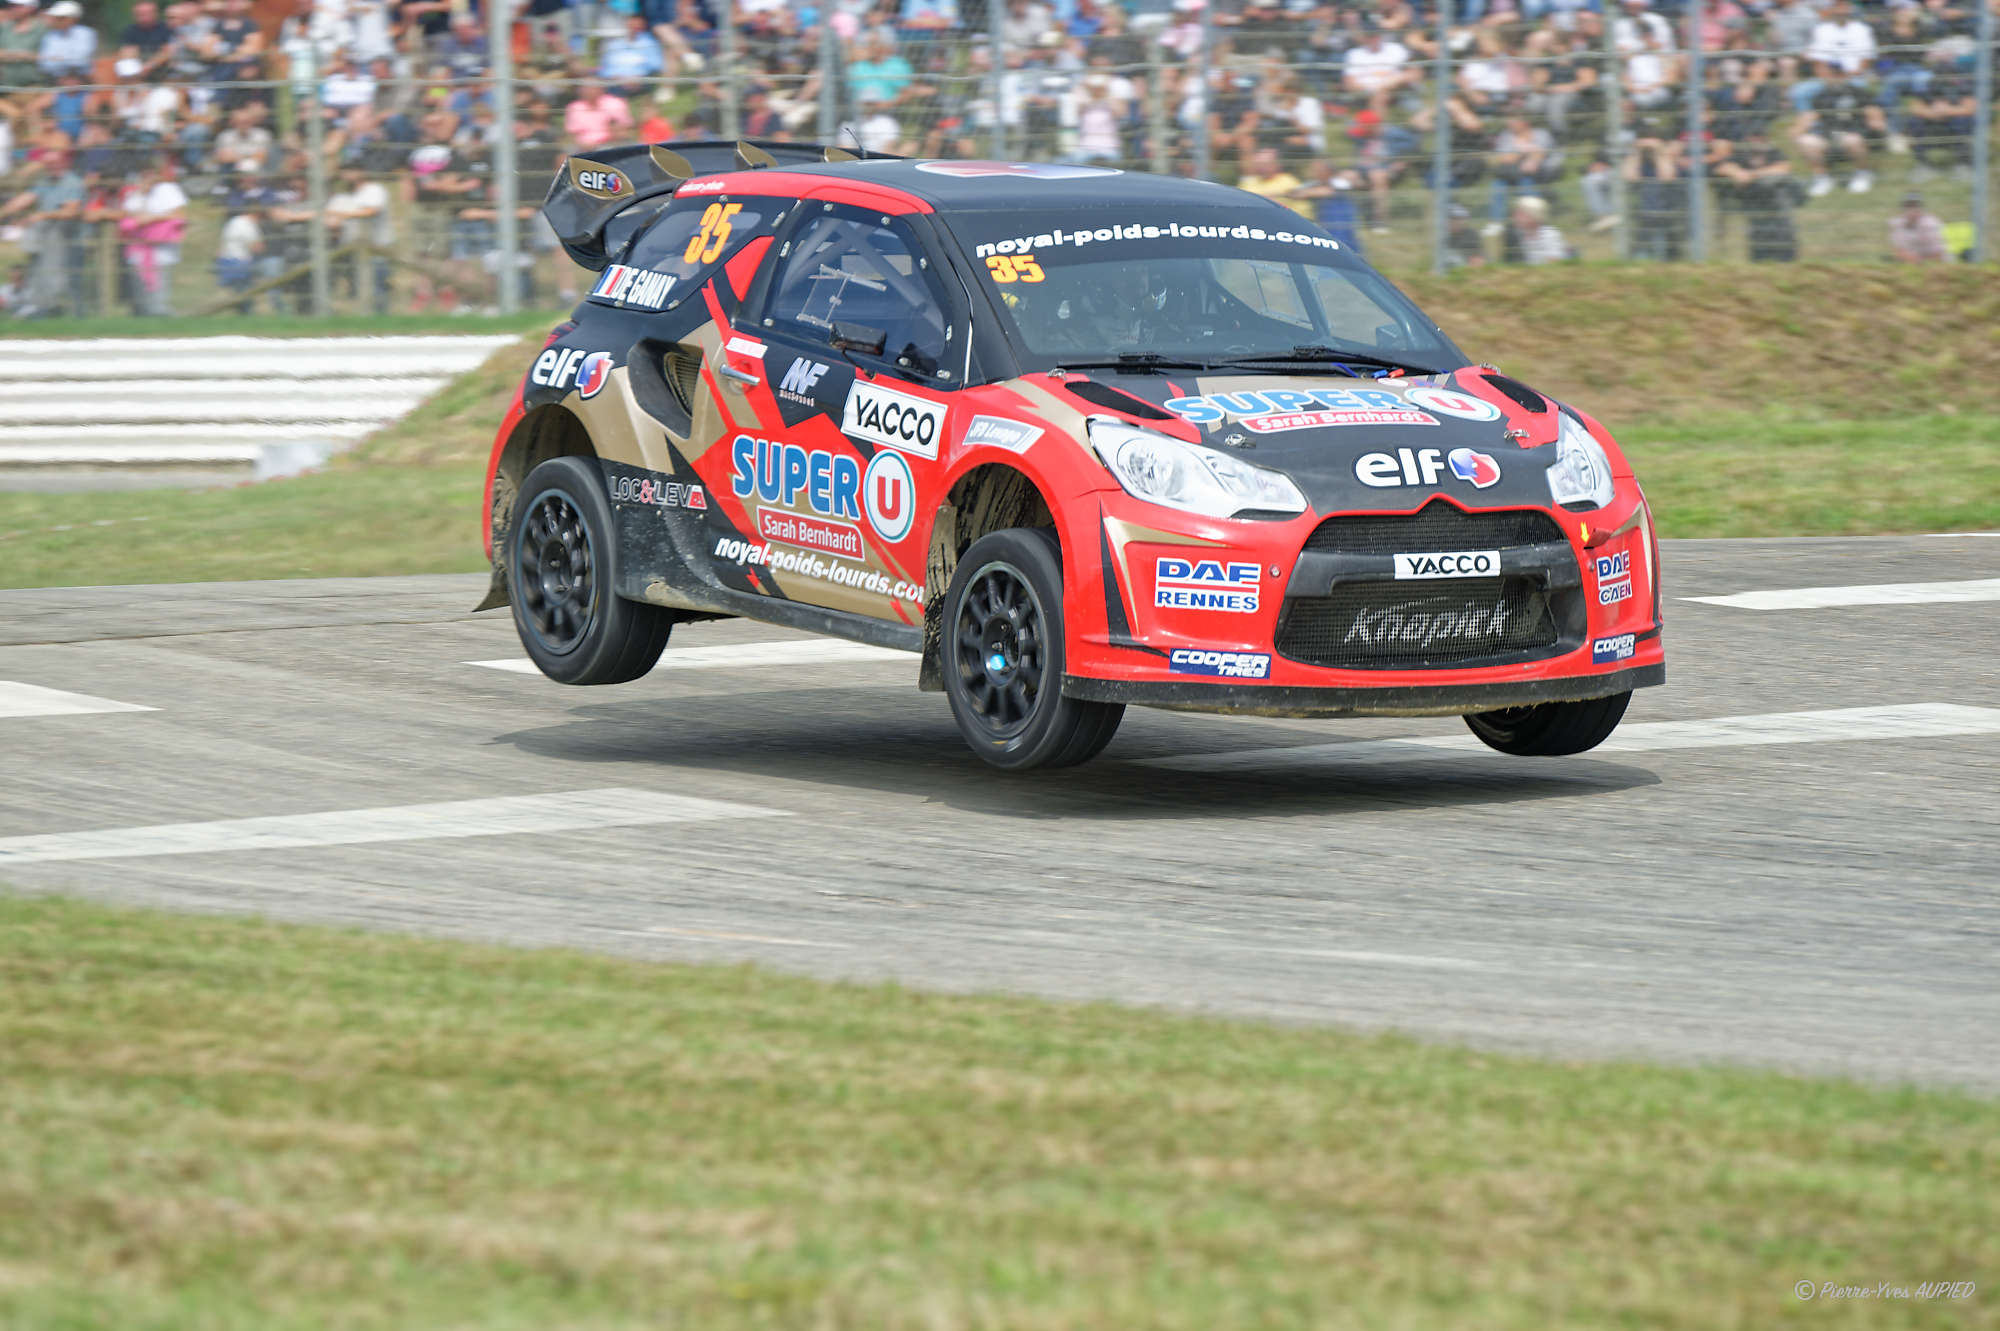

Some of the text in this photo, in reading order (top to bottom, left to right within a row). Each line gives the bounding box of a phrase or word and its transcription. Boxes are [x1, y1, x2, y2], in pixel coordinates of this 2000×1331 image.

[579, 171, 607, 190] elf
[683, 202, 743, 264] 35
[976, 222, 1340, 258] noyal-poids-lourds.com
[985, 254, 1046, 283] 35
[611, 266, 677, 309] DE GANAY
[532, 348, 586, 388] elf
[1163, 388, 1419, 423] SUPER
[856, 394, 935, 446] YACCO
[1257, 410, 1424, 432] Sarah Bernhardt
[732, 434, 901, 521] SUPER U
[1355, 448, 1445, 487] elf
[763, 513, 857, 553] Sarah Bernhardt
[1158, 560, 1259, 582] DAF
[1408, 555, 1491, 576] YACCO
[1597, 552, 1629, 577] DAF
[1157, 590, 1258, 611] RENNES
[1600, 582, 1631, 602] CAEN
[1593, 634, 1635, 654] COOPER
[1171, 650, 1270, 668] COOPER
[1217, 664, 1266, 678] TIRES
